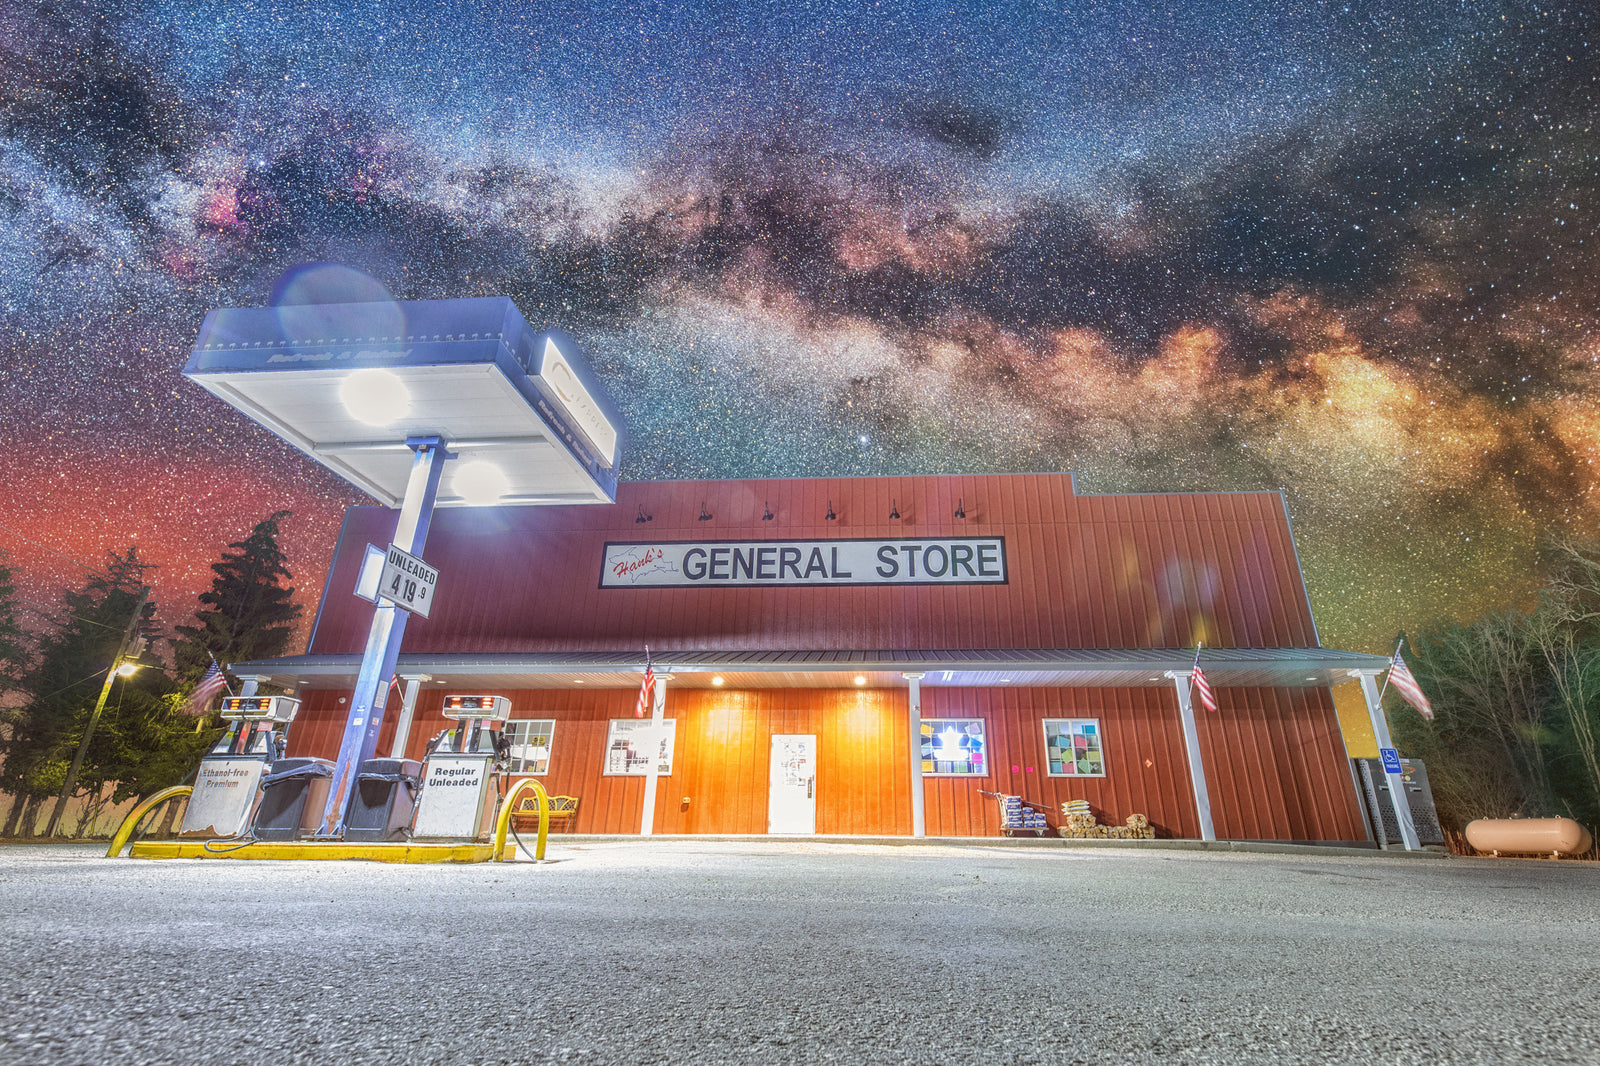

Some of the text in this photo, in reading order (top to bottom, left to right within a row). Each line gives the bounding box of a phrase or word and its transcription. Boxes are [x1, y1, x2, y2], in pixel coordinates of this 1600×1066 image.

[388, 550, 436, 585] UNLEADED
[612, 547, 663, 578] Hank's
[682, 544, 1001, 581] GENERAL STORE
[202, 768, 249, 777] Ethanol-free
[434, 767, 476, 777] Regular
[206, 779, 239, 788] Premium
[428, 778, 479, 787] Unleaded
